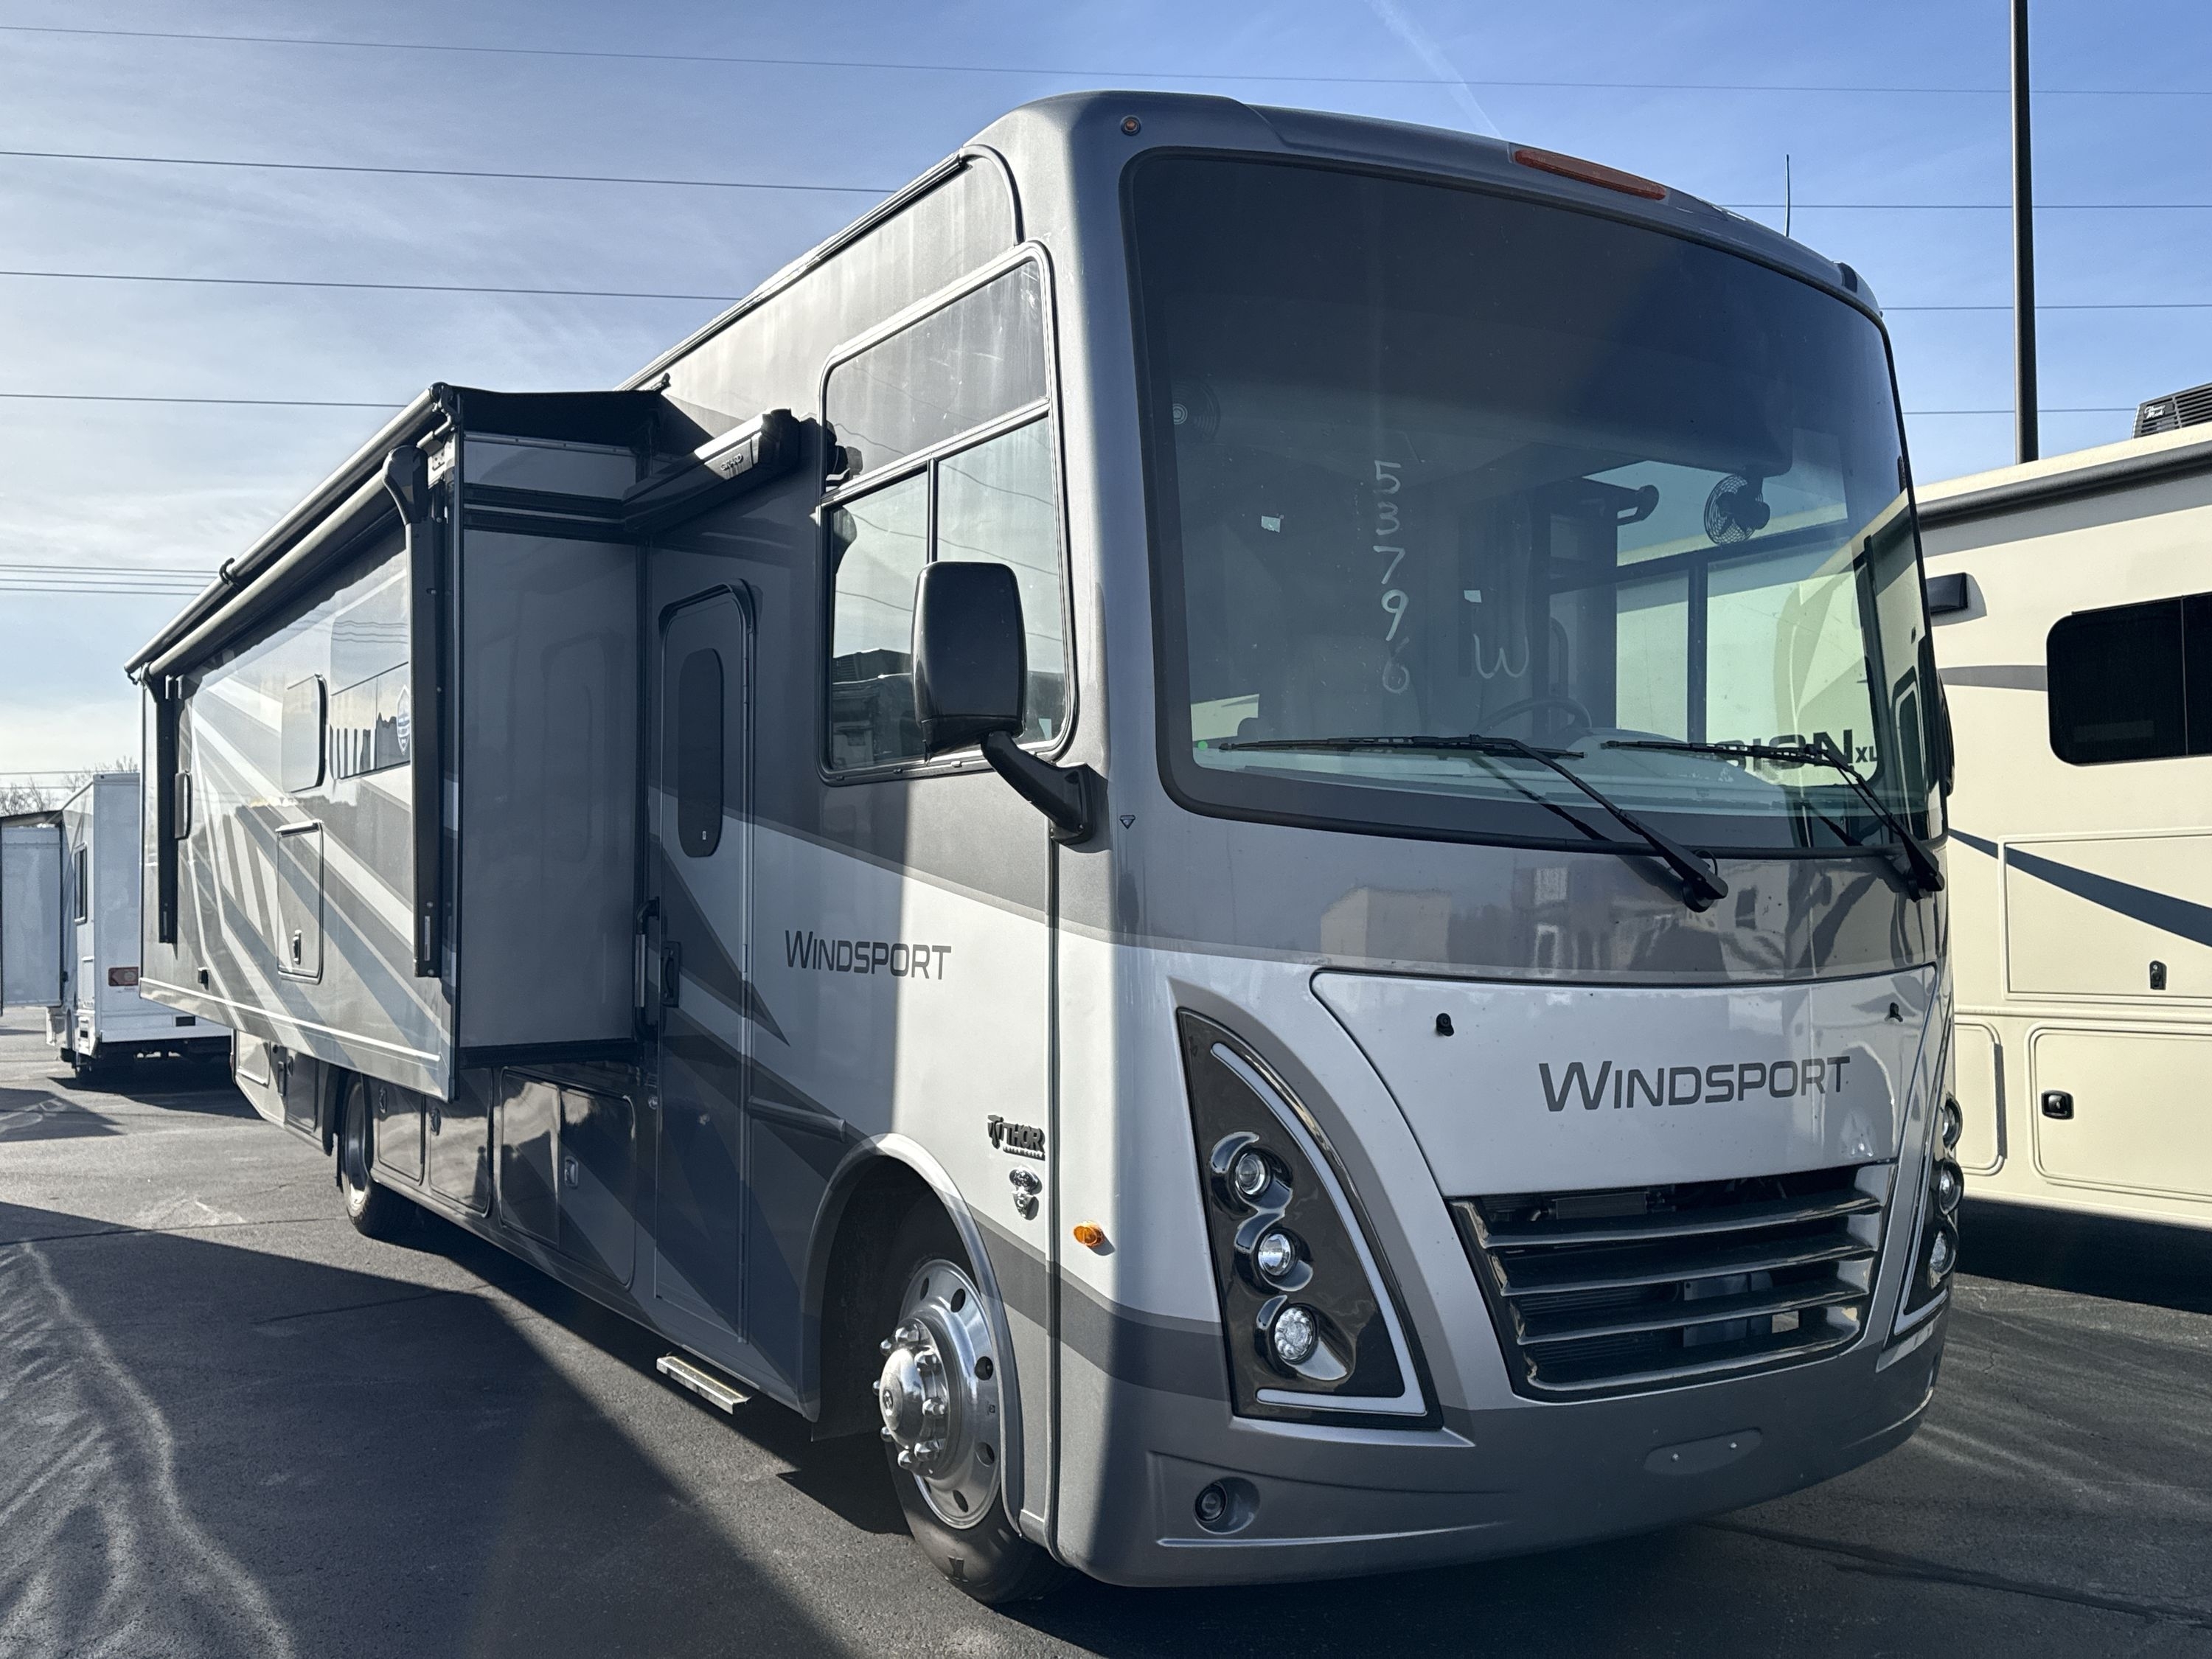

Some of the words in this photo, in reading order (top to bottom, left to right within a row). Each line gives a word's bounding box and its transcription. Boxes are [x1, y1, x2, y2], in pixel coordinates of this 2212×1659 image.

[785, 930, 952, 980] WINDSPORT
[1538, 1055, 1850, 1112] WINDSPORT
[1003, 1121, 1045, 1152] THOR
